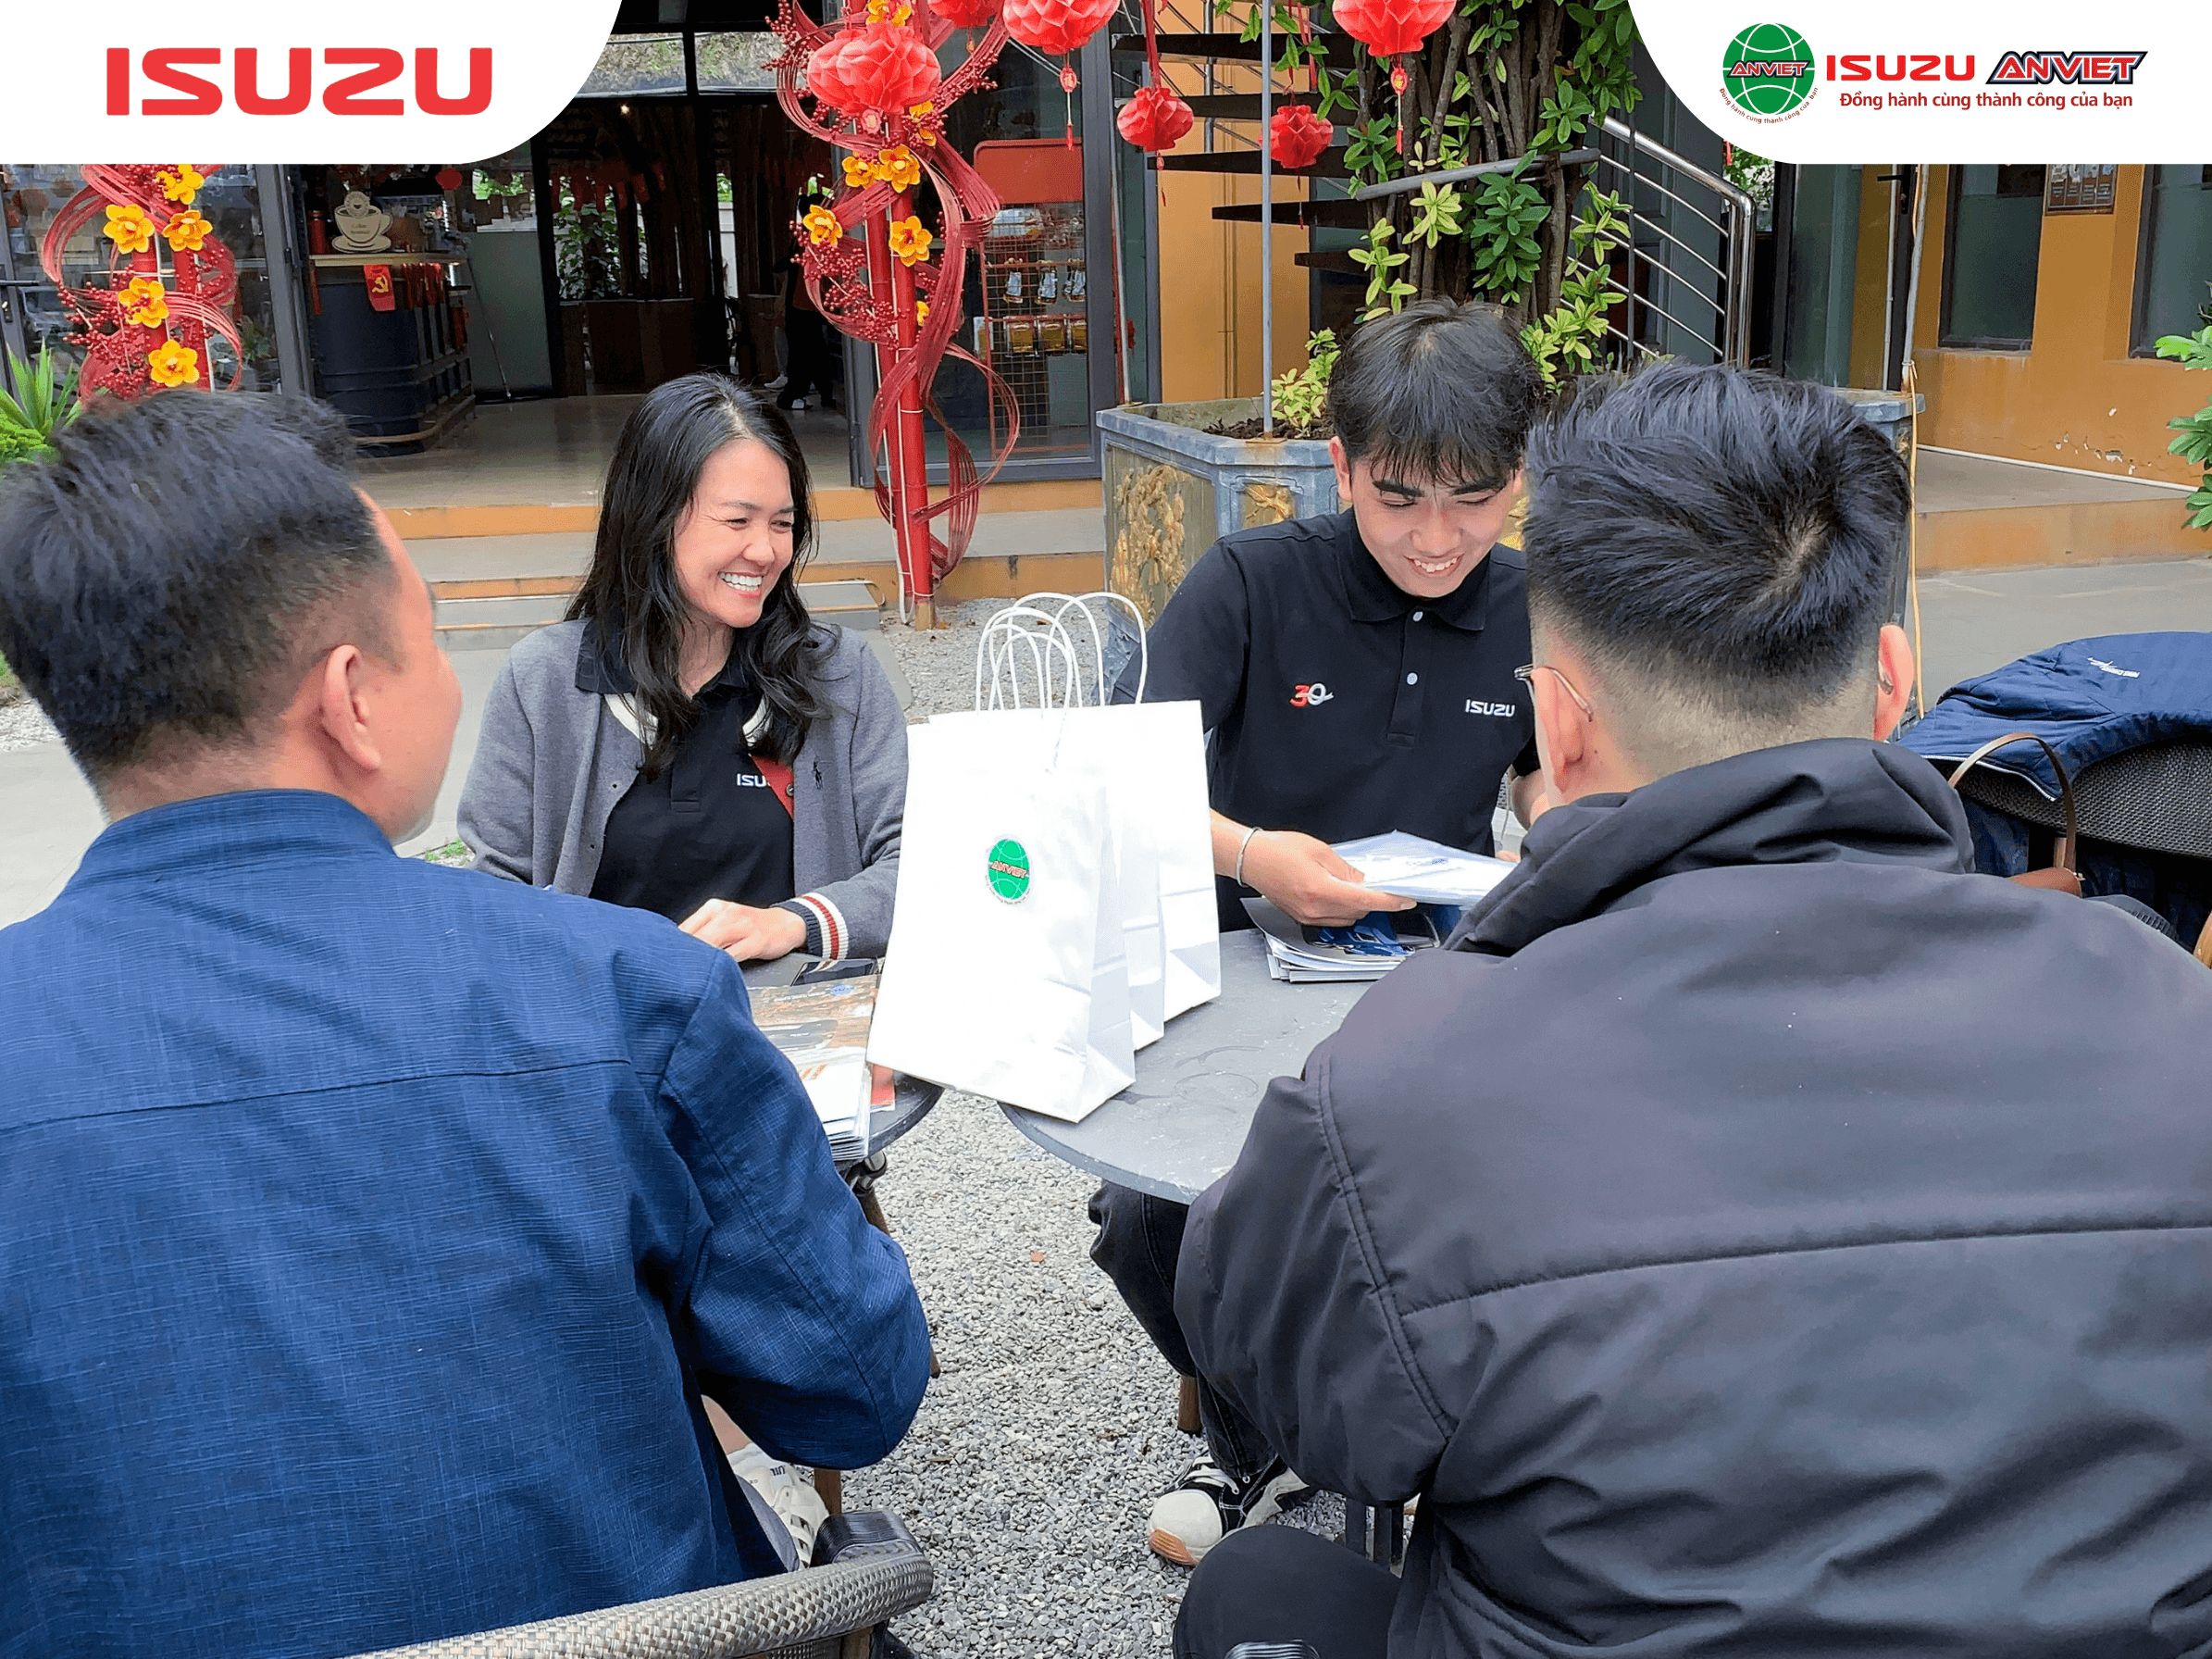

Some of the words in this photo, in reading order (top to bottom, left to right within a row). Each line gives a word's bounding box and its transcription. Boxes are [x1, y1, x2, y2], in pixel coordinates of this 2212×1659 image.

[1290, 682, 1334, 707] 30
[1465, 699, 1515, 717] ISUZU
[737, 773, 770, 787] ISU
